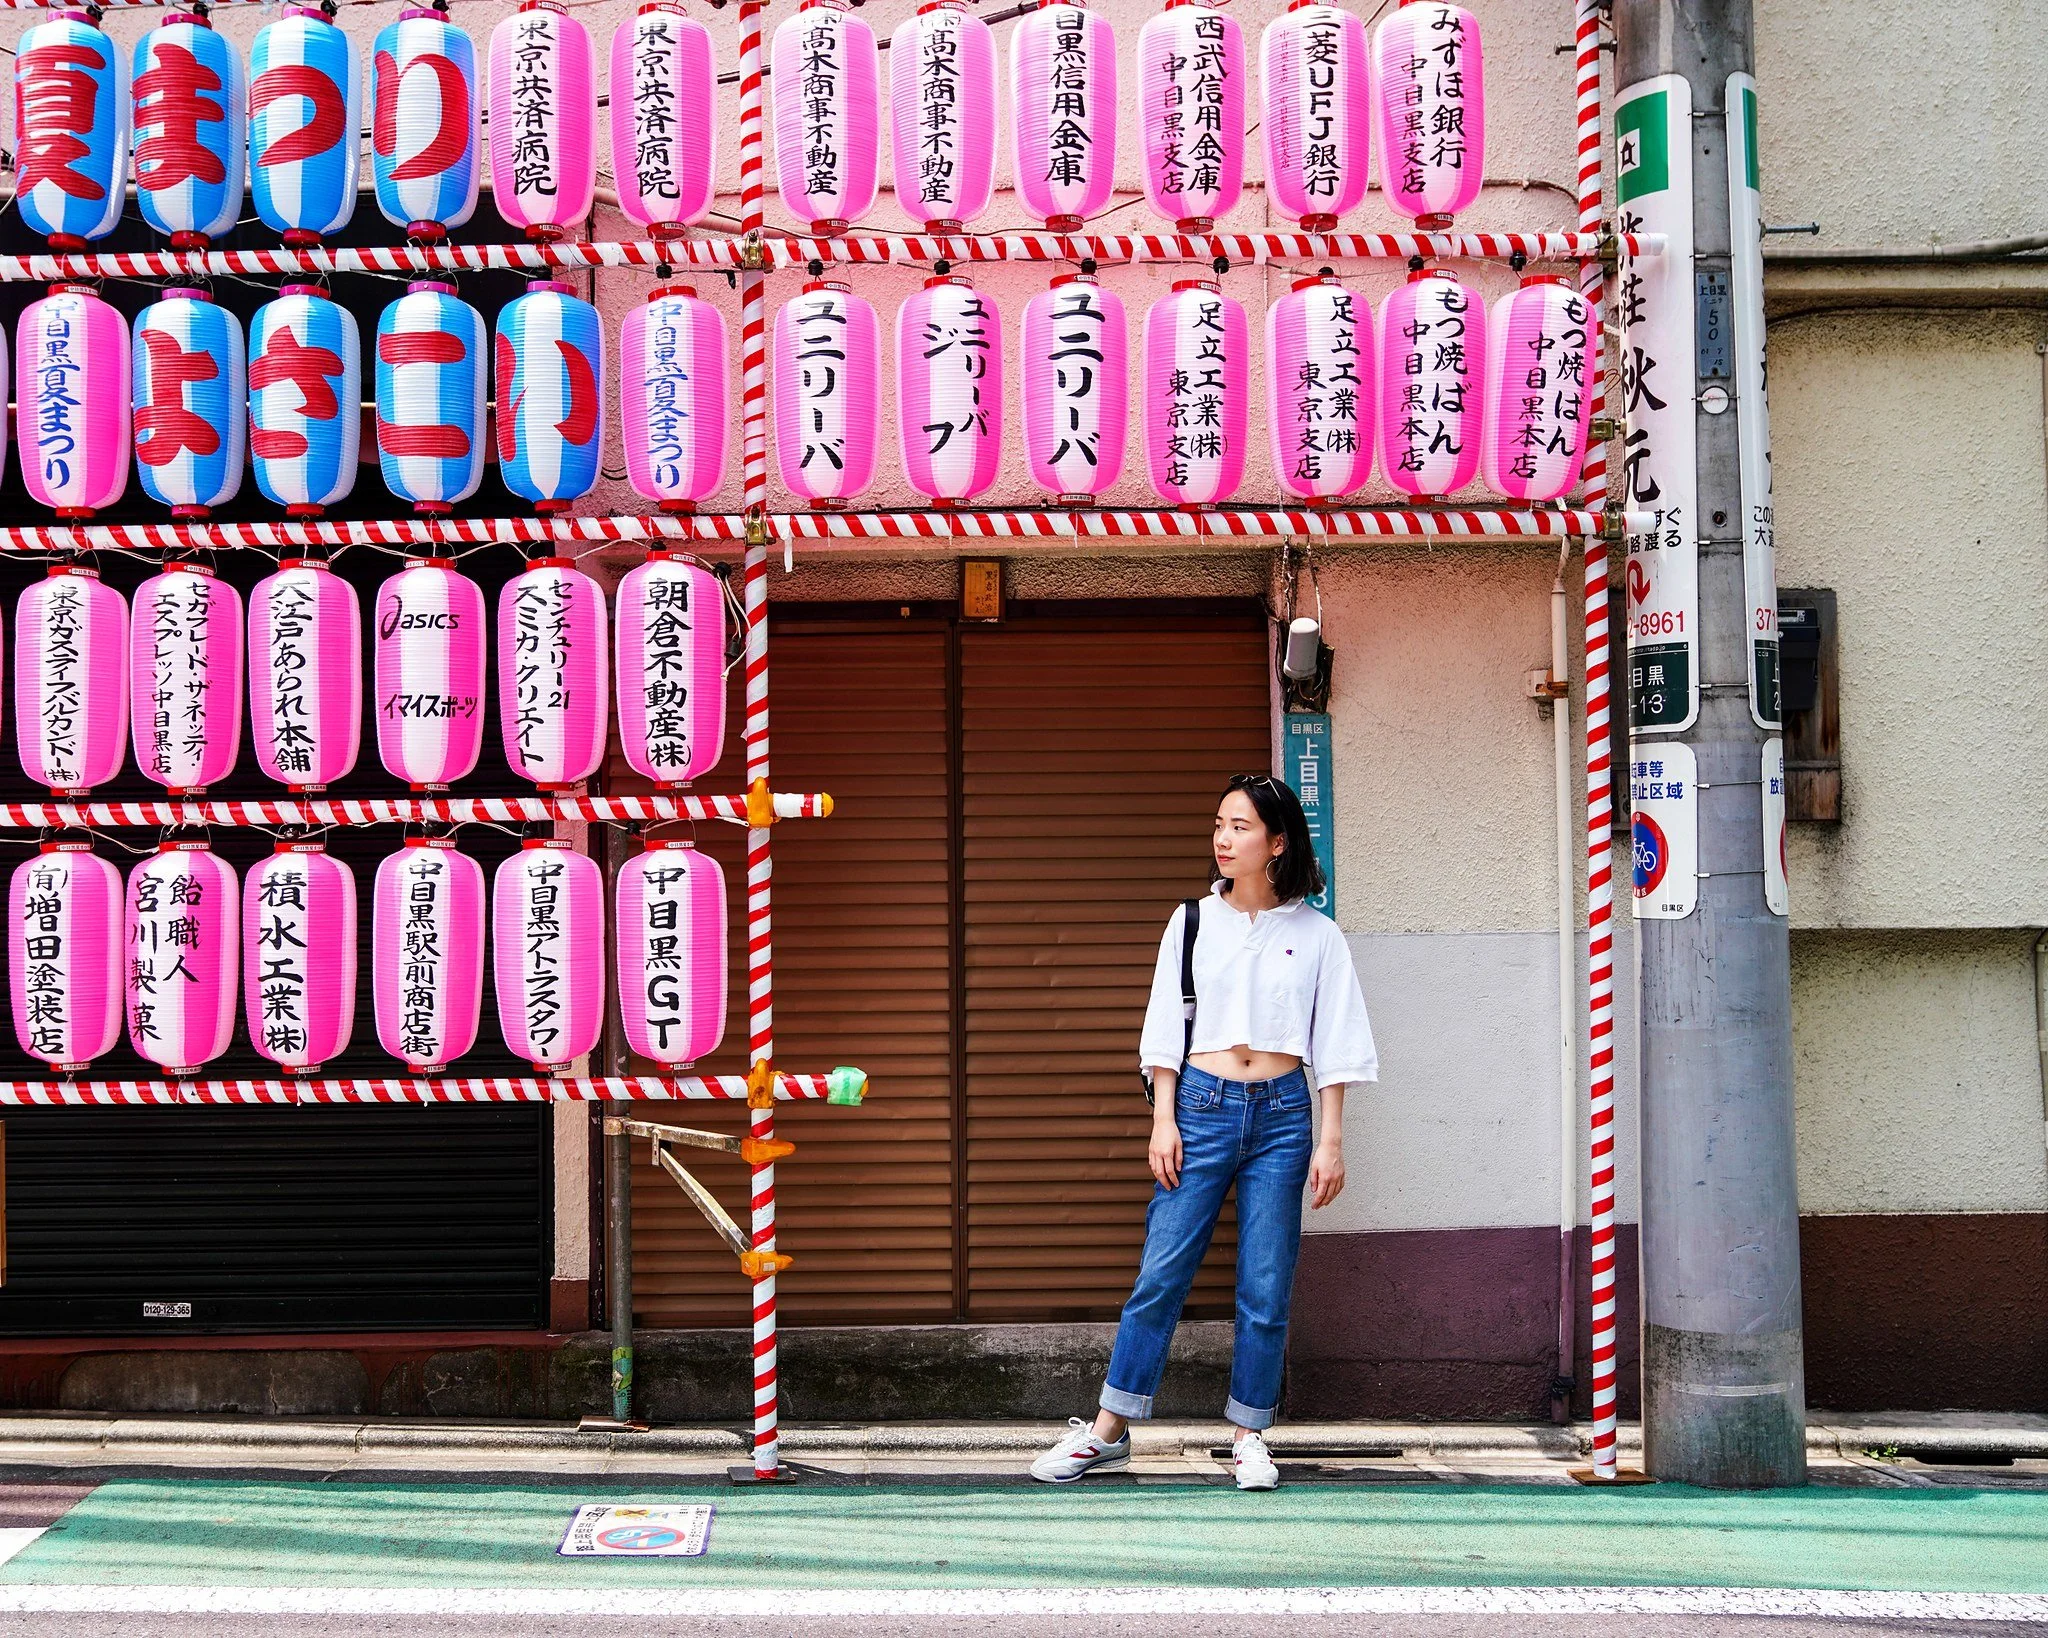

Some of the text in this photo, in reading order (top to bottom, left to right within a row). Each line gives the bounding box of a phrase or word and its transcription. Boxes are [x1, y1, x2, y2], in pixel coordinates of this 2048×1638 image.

[133, 43, 226, 191] ま
[250, 65, 347, 167] つ
[373, 50, 469, 181] り
[511, 16, 557, 196] 東京共済病院
[632, 21, 680, 199] 東京共済病院
[1043, 10, 1092, 187] 目黒信用金庫
[1161, 53, 1187, 195] 中目黒支店
[1188, 16, 1231, 196] 西武信用金庫
[1302, 10, 1341, 197] 三菱UFJ銀行
[1400, 54, 1428, 194] 中目黒支店
[1429, 9, 1467, 169] みずほ銀行
[134, 325, 598, 466] よ さ こ い
[643, 301, 689, 489] 中目黒夏まつり
[796, 301, 847, 470] ユニリーバ
[959, 299, 990, 436] ユニリーバ
[1047, 293, 1105, 466] ユニリーバ
[1164, 369, 1192, 486] 東京支店
[1293, 361, 1327, 480] 東京支店
[1395, 319, 1430, 472] 中目黒本店
[1428, 287, 1472, 455] もつ焼ばん
[1509, 331, 1555, 478] 中目黒本店
[1546, 297, 1589, 457] もつ焼ばん
[1626, 529, 1682, 556] 路渡る
[1754, 506, 1774, 526] この
[151, 593, 182, 774] エスプレッソ中目黒店
[383, 693, 478, 719] イマイスポーツ
[546, 579, 575, 710] センチュリー21
[643, 578, 692, 767] 朝倉不動産(株)
[1628, 665, 1664, 689] 目黒
[1292, 723, 1324, 734] 目黒区
[23, 864, 68, 1055] (有)増田塗装店
[130, 872, 164, 1042] 宮川製菓
[163, 874, 204, 983] 飴職人
[257, 871, 308, 1053] 積水工業(株)
[400, 859, 443, 1057] 中目黒駅前商店街
[526, 860, 564, 1058] 中目黒アトラスタワー
[643, 862, 686, 1050] 中目黒GT
[1662, 904, 1684, 912] 目黒区
[145, 1306, 190, 1314] 0120-129-365
